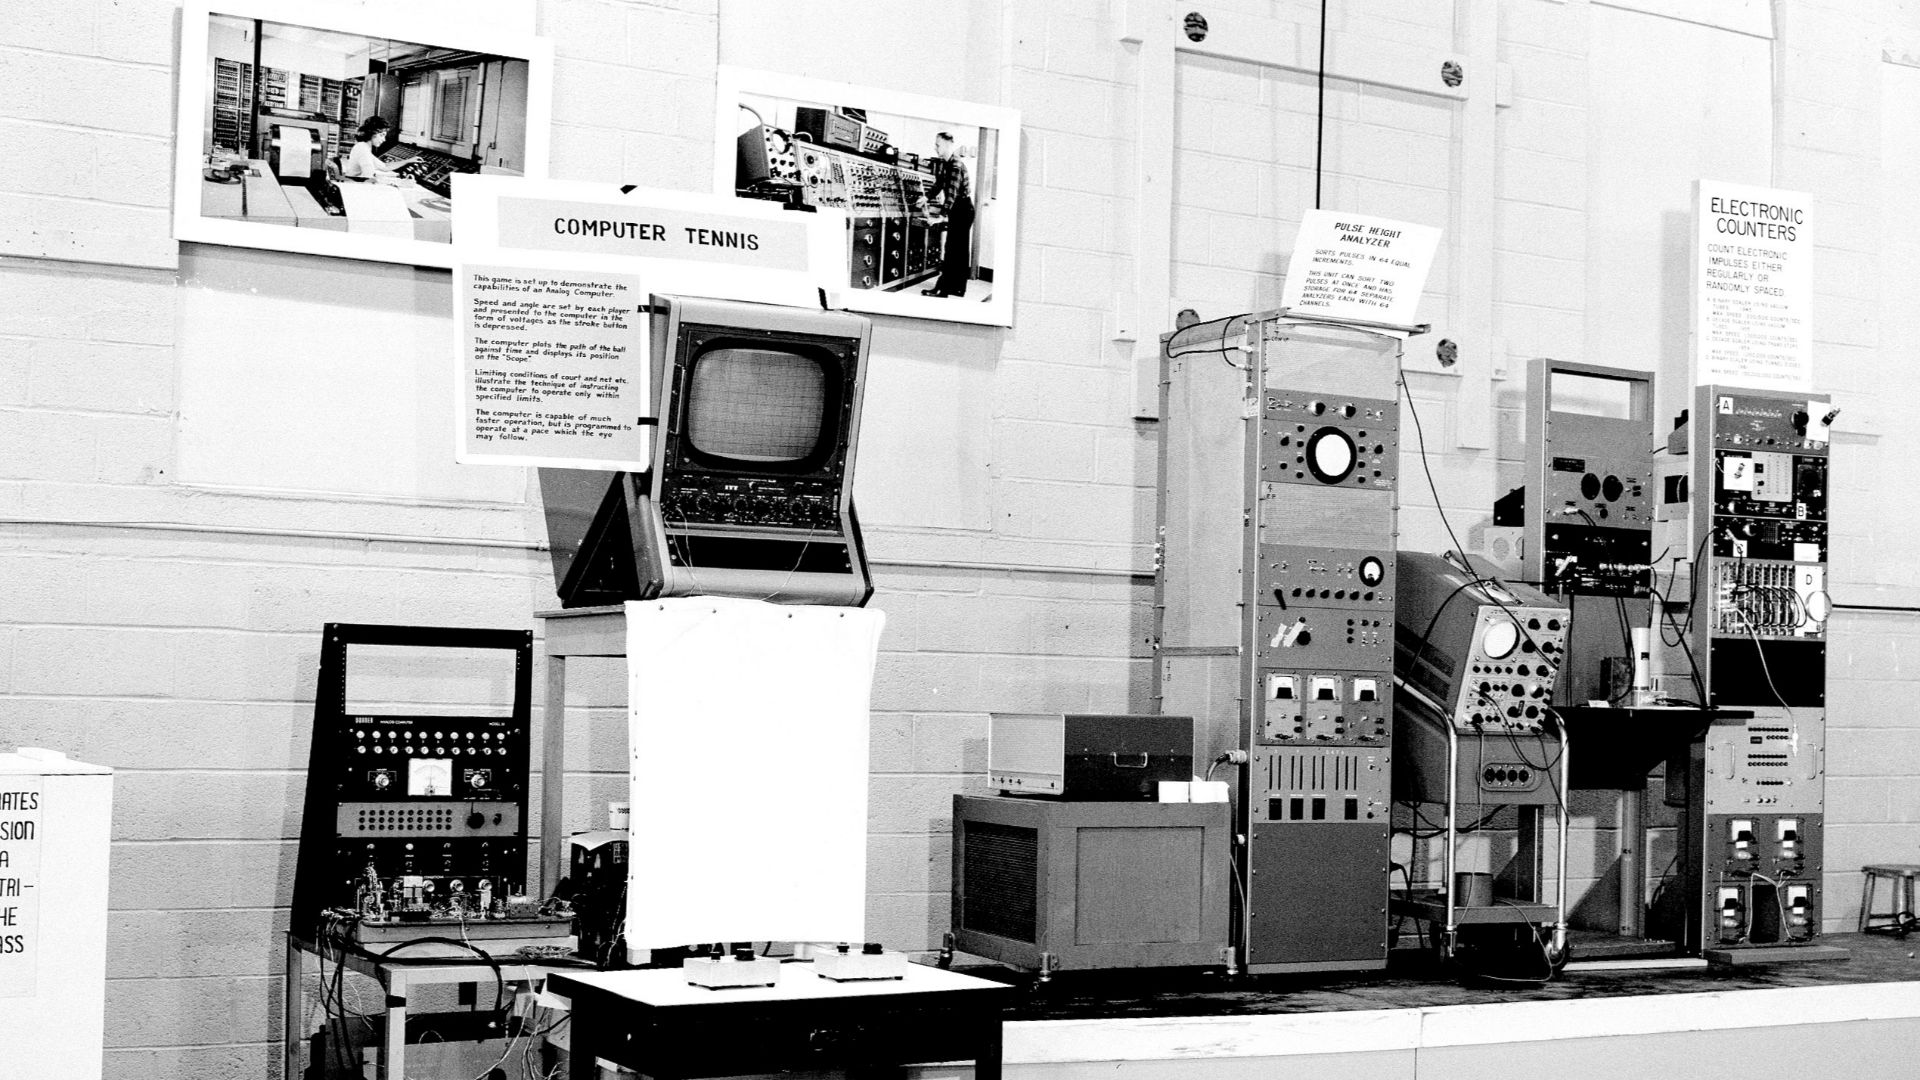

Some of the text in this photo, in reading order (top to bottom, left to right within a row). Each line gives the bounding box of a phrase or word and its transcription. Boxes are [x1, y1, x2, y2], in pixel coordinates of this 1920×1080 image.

[1711, 198, 1803, 224] ELECTRONIC
[554, 219, 758, 250] COMPUTER TENNIS
[1334, 222, 1402, 238] PULSE HEIGHT
[1716, 218, 1796, 241] COUNTERS
[1340, 234, 1390, 248] ANALYZER
[538, 280, 548, 288] up
[559, 280, 612, 290] demonstrate
[545, 286, 570, 297] Analog
[473, 298, 498, 308] Speed
[519, 301, 539, 311] angle
[574, 304, 584, 314] by
[607, 306, 630, 316] player
[490, 308, 529, 316] presented
[559, 312, 597, 321] computer
[474, 314, 493, 322] form
[509, 316, 543, 326] voltages
[574, 319, 600, 327] stroke
[602, 321, 627, 329] button
[482, 321, 527, 332] depressed.
[490, 339, 529, 349] computer
[532, 340, 551, 350] plots
[569, 342, 586, 352] path
[474, 346, 501, 355] against
[542, 349, 572, 360] displays
[589, 352, 619, 361] position
[474, 368, 506, 380] Limiting
[509, 371, 547, 379] conditions
[530, 379, 565, 390] technique
[490, 386, 527, 395] computer
[541, 388, 571, 398] operate
[574, 389, 591, 400] only
[595, 390, 619, 398] within
[516, 394, 543, 402] limits.
[1723, 400, 1729, 410] A
[492, 410, 532, 419] computer
[544, 412, 574, 421] capable
[475, 416, 500, 424] faster
[503, 418, 544, 429] operation,
[475, 424, 506, 434] operate
[598, 431, 612, 439] eye
[475, 433, 527, 442] may follow.
[1798, 506, 1804, 516] B
[1806, 574, 1813, 585] D
[0, 792, 39, 810] ATES
[0, 935, 24, 954] SS
